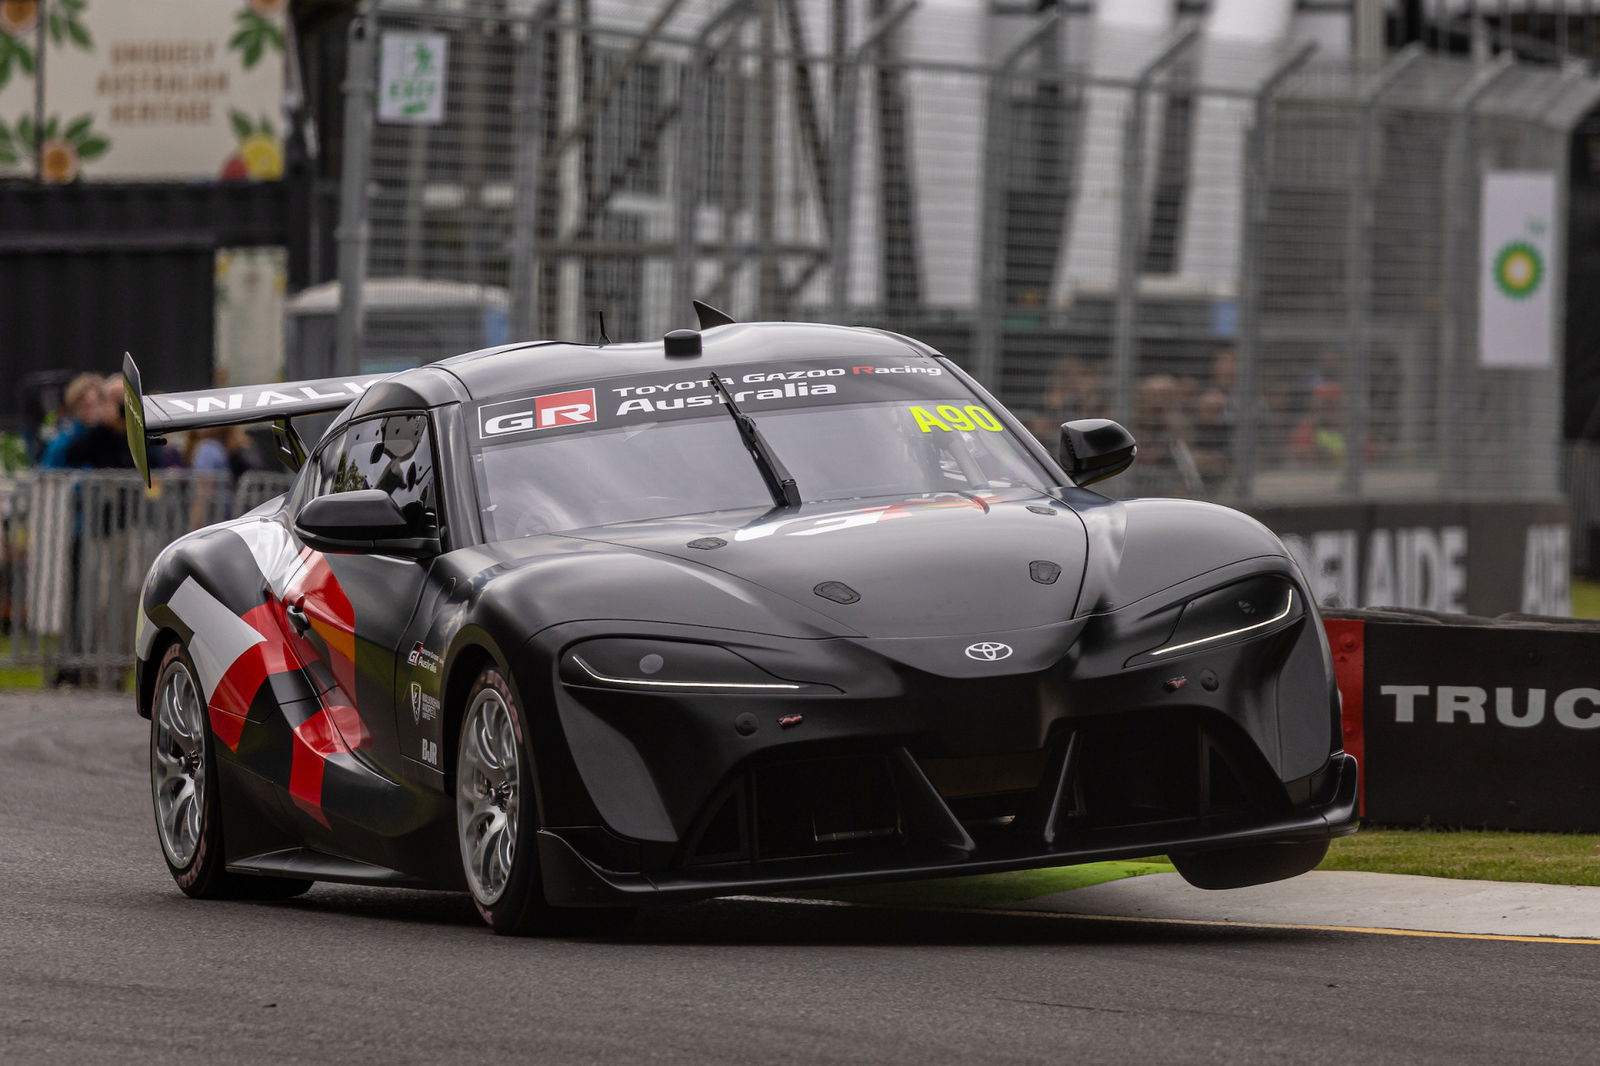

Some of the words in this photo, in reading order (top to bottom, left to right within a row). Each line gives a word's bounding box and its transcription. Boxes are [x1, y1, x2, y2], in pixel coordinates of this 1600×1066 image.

[97, 73, 230, 95] AUSTRALIAN
[111, 103, 213, 124] HERITAGE
[612, 377, 735, 397] TOYOTA
[742, 368, 846, 383] GAZOO
[852, 365, 942, 376] Racing
[616, 382, 837, 416] Australia
[485, 403, 592, 434] GR
[909, 405, 1004, 433] A90
[1380, 685, 1600, 730] TRUC
[422, 738, 438, 766] BJR
